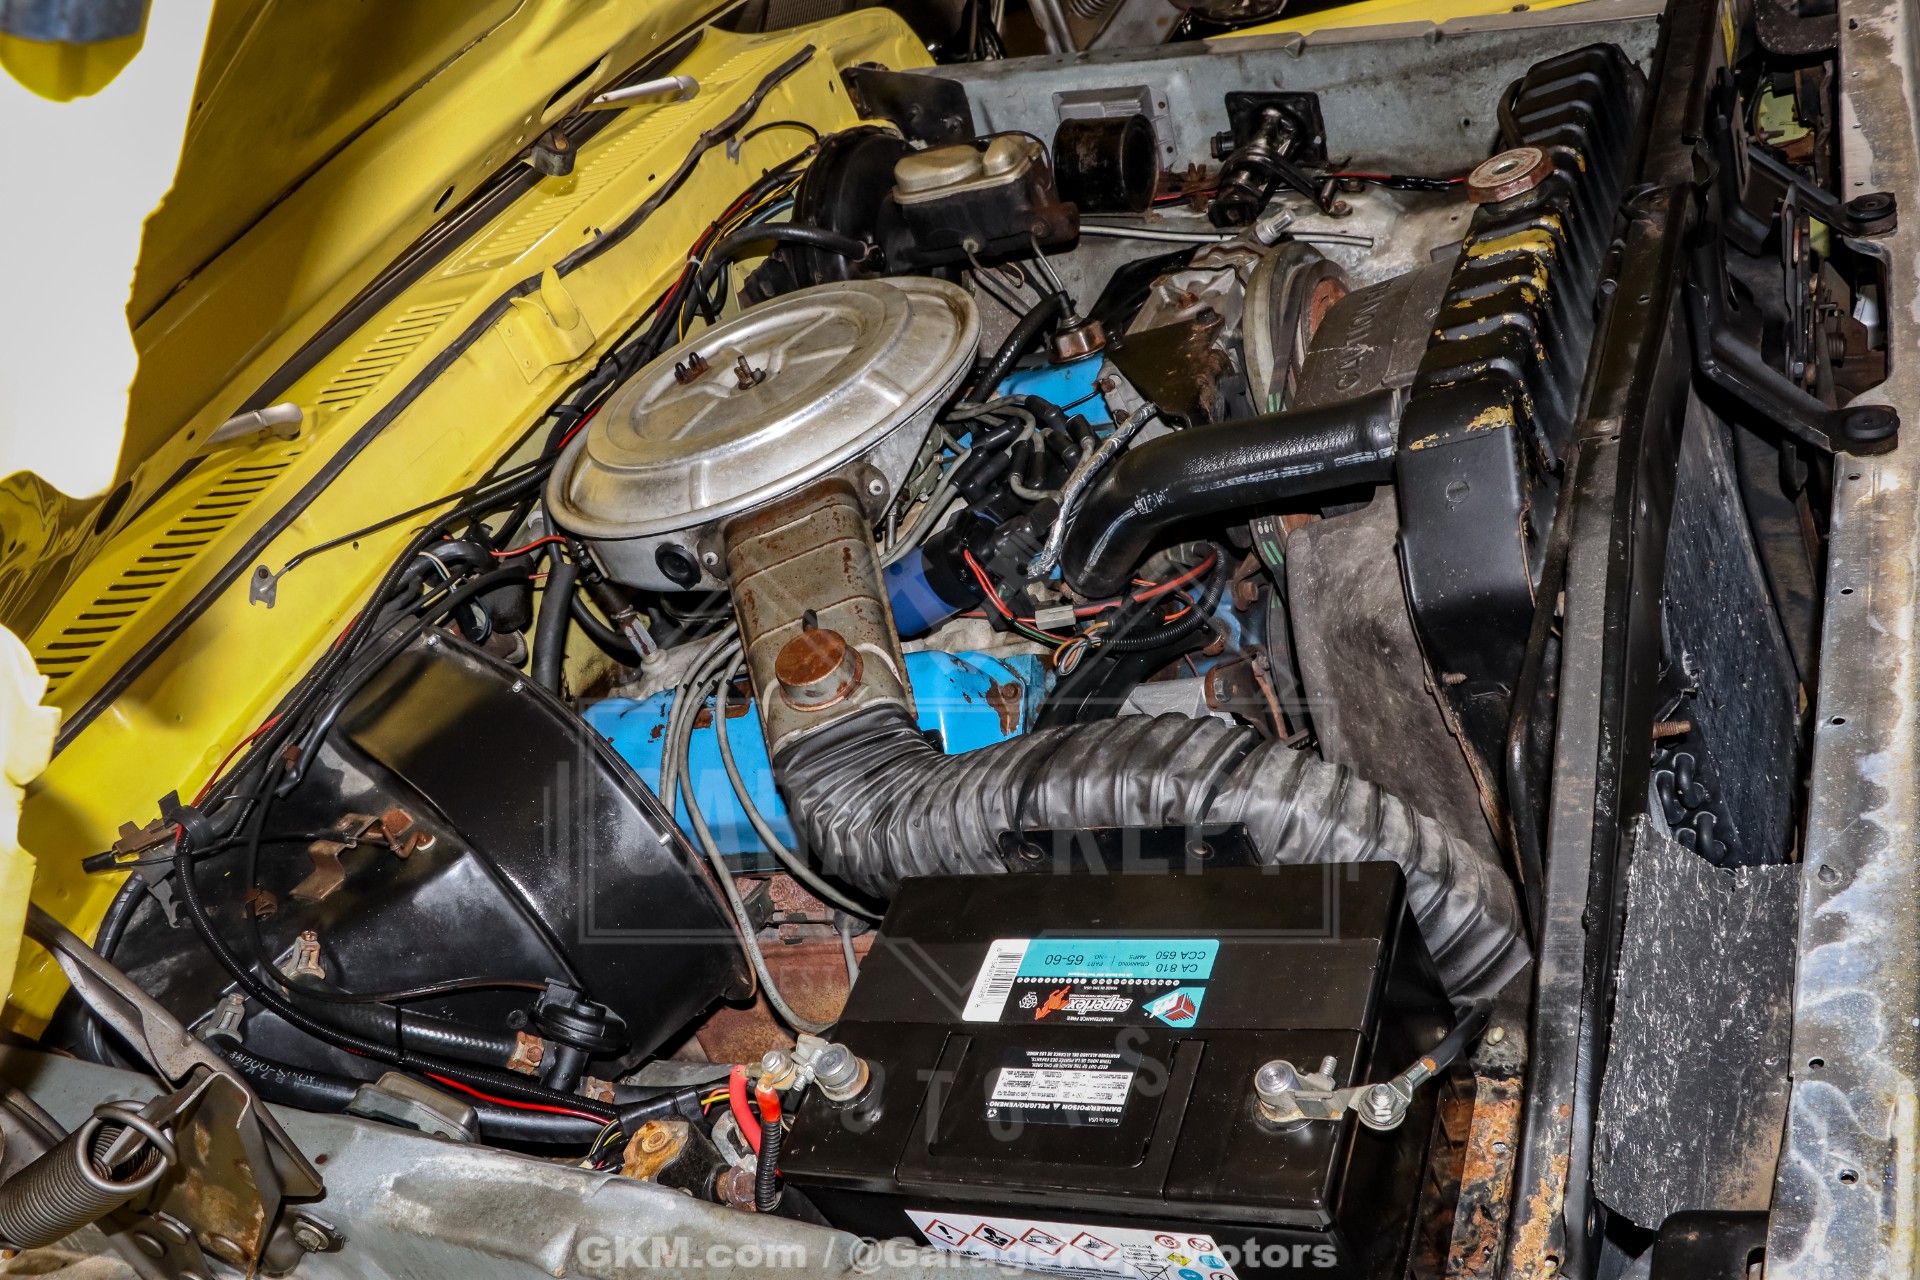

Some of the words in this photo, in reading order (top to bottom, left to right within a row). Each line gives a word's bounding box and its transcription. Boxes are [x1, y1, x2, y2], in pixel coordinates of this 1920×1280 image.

[1044, 954, 1084, 965] 65-60
[1156, 951, 1177, 960] 650
[1180, 951, 1206, 960] CCA
[1156, 963, 1177, 973] 810
[1181, 963, 1198, 973] CA
[989, 1101, 1051, 1109] PELIGRO/VENENO
[1061, 1104, 1123, 1113] DANGER/POISON
